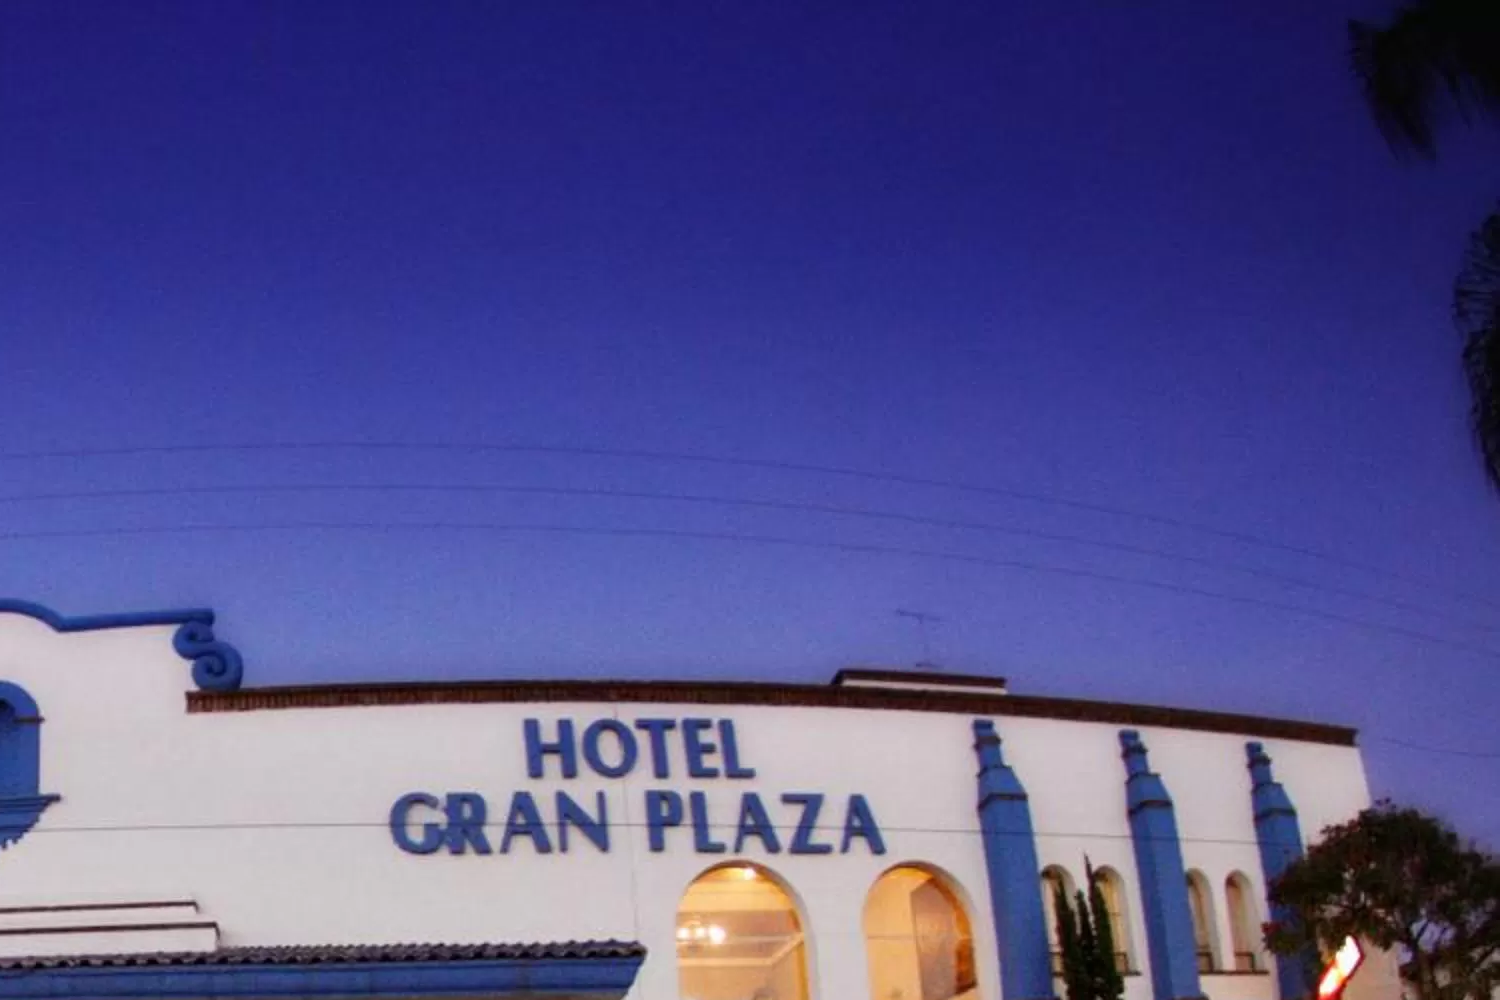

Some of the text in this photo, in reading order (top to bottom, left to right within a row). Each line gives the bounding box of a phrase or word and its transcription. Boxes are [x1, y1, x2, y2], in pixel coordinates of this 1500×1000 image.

[522, 717, 757, 780] HOTEL
[387, 789, 887, 857] GRAN PLAZA
